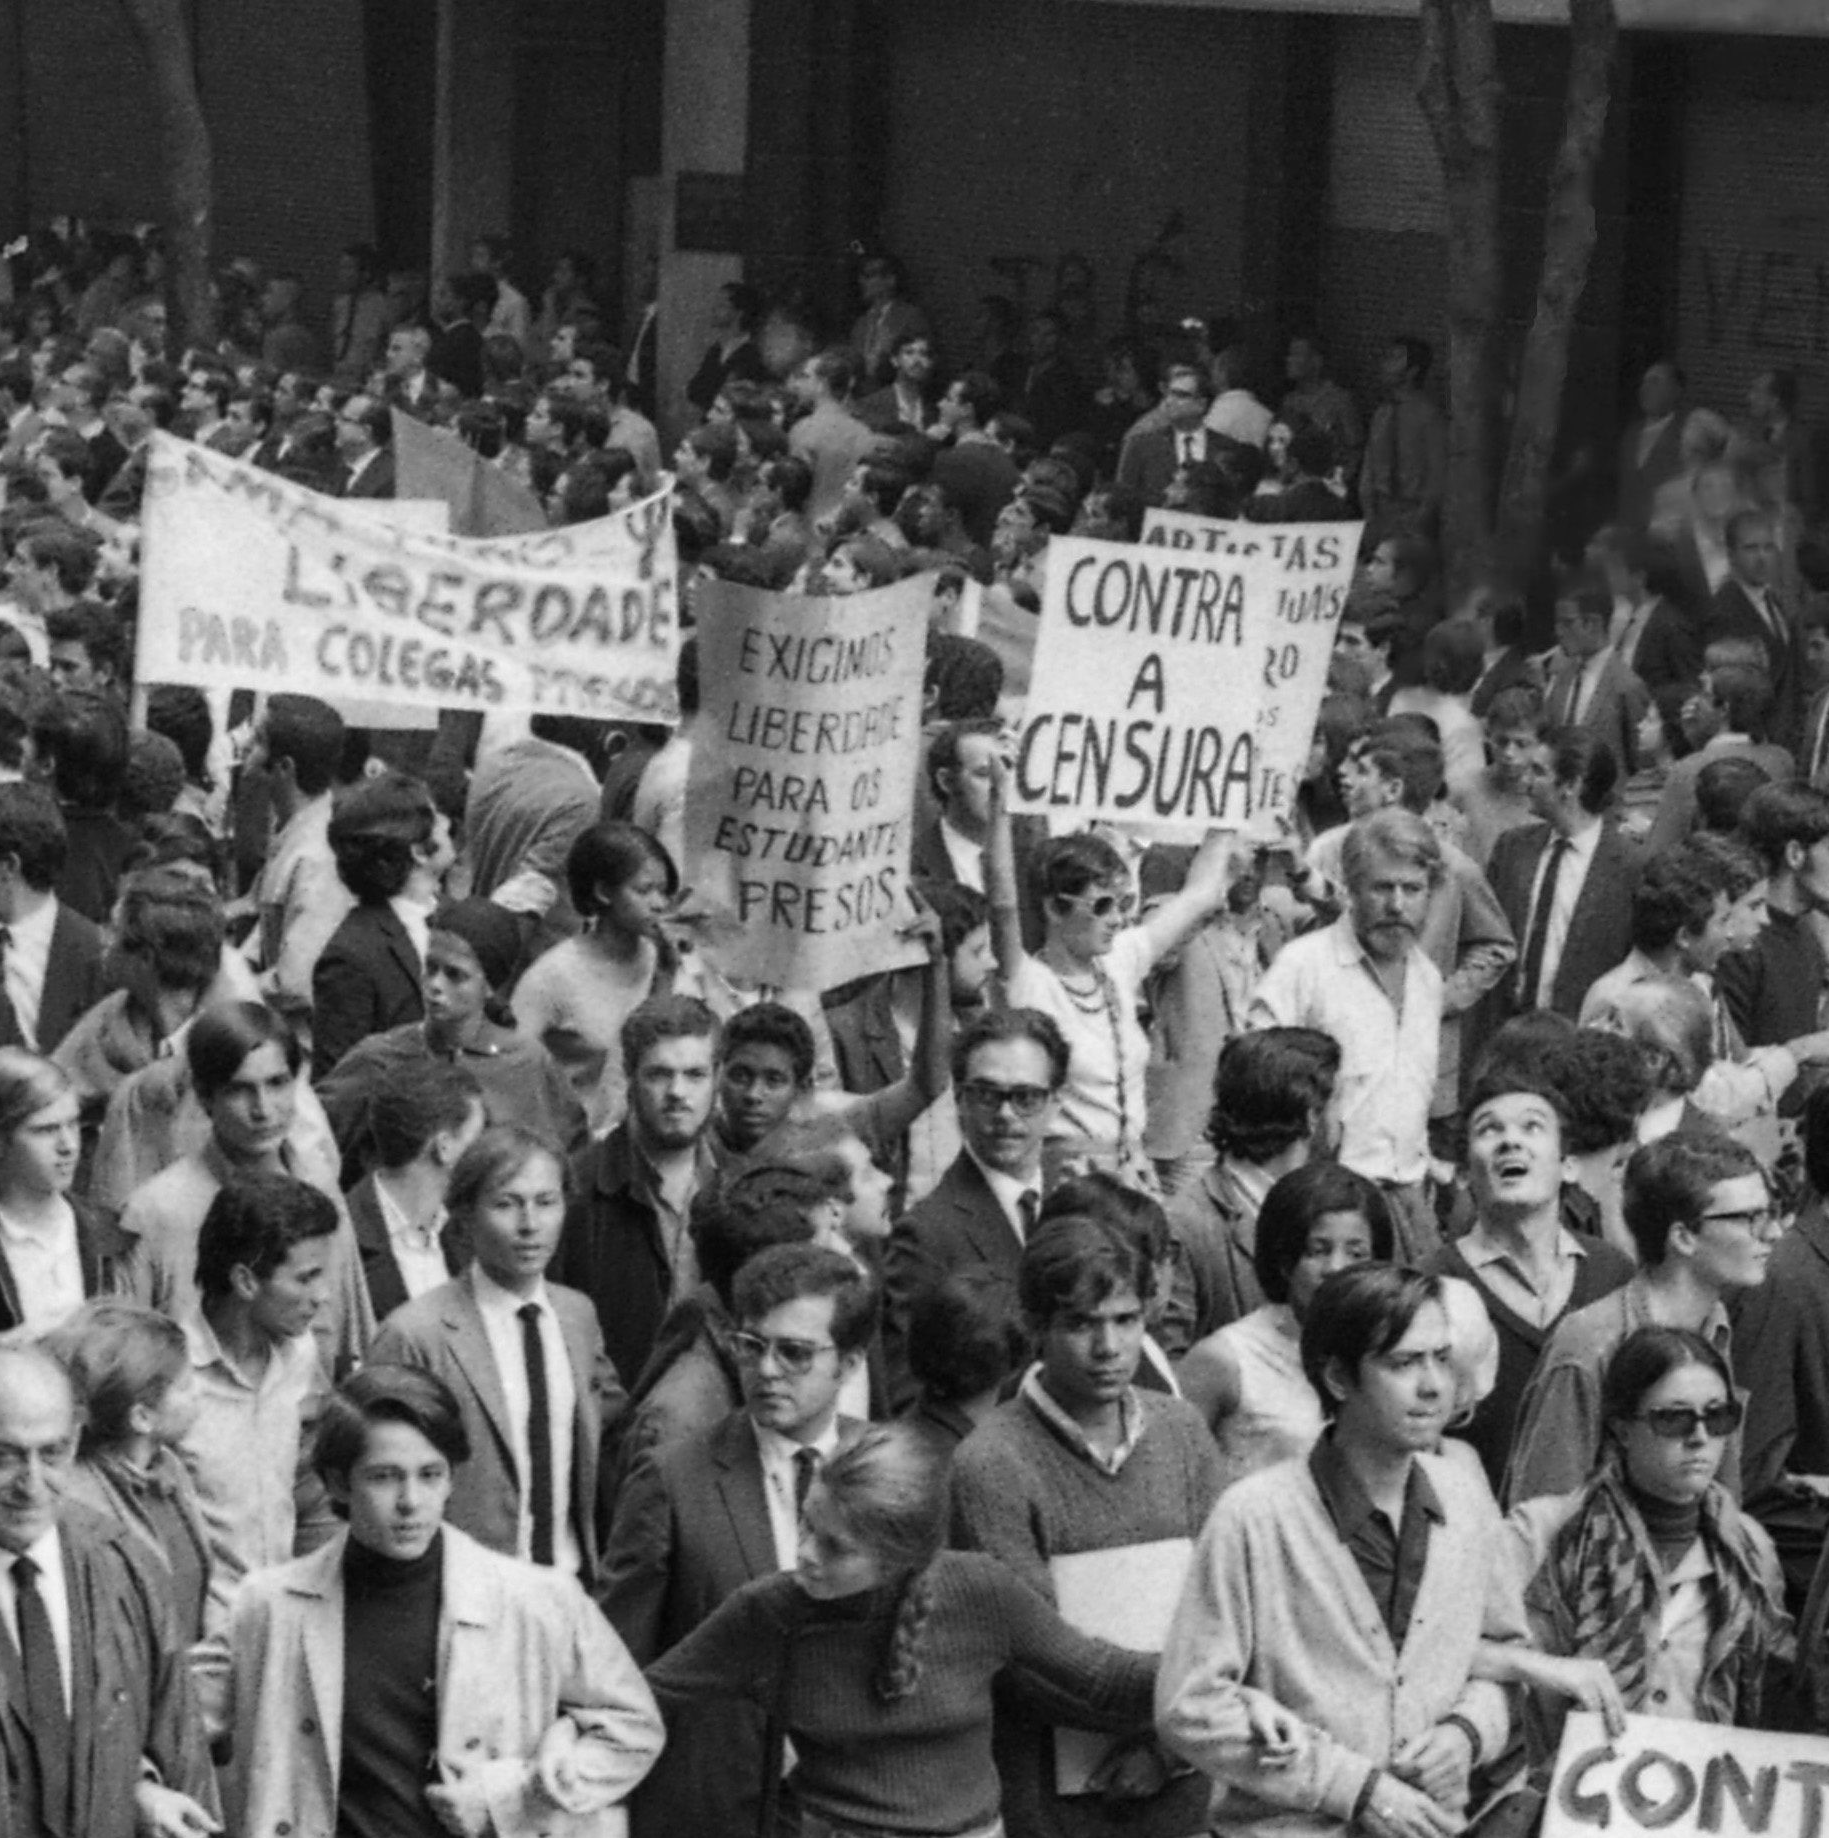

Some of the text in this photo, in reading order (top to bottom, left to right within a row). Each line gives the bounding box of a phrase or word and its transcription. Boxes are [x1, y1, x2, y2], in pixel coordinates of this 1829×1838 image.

[281, 544, 673, 649] LIBERDADE
[1065, 555, 1245, 647] CONTRA
[176, 605, 289, 675] PARA
[314, 622, 506, 703] COLEGAS
[1126, 652, 1165, 714] A
[726, 695, 905, 756] LIBERDADE
[1014, 712, 1254, 819] CENSURA
[732, 765, 882, 814] PARA OS
[737, 866, 897, 934] PRESOS
